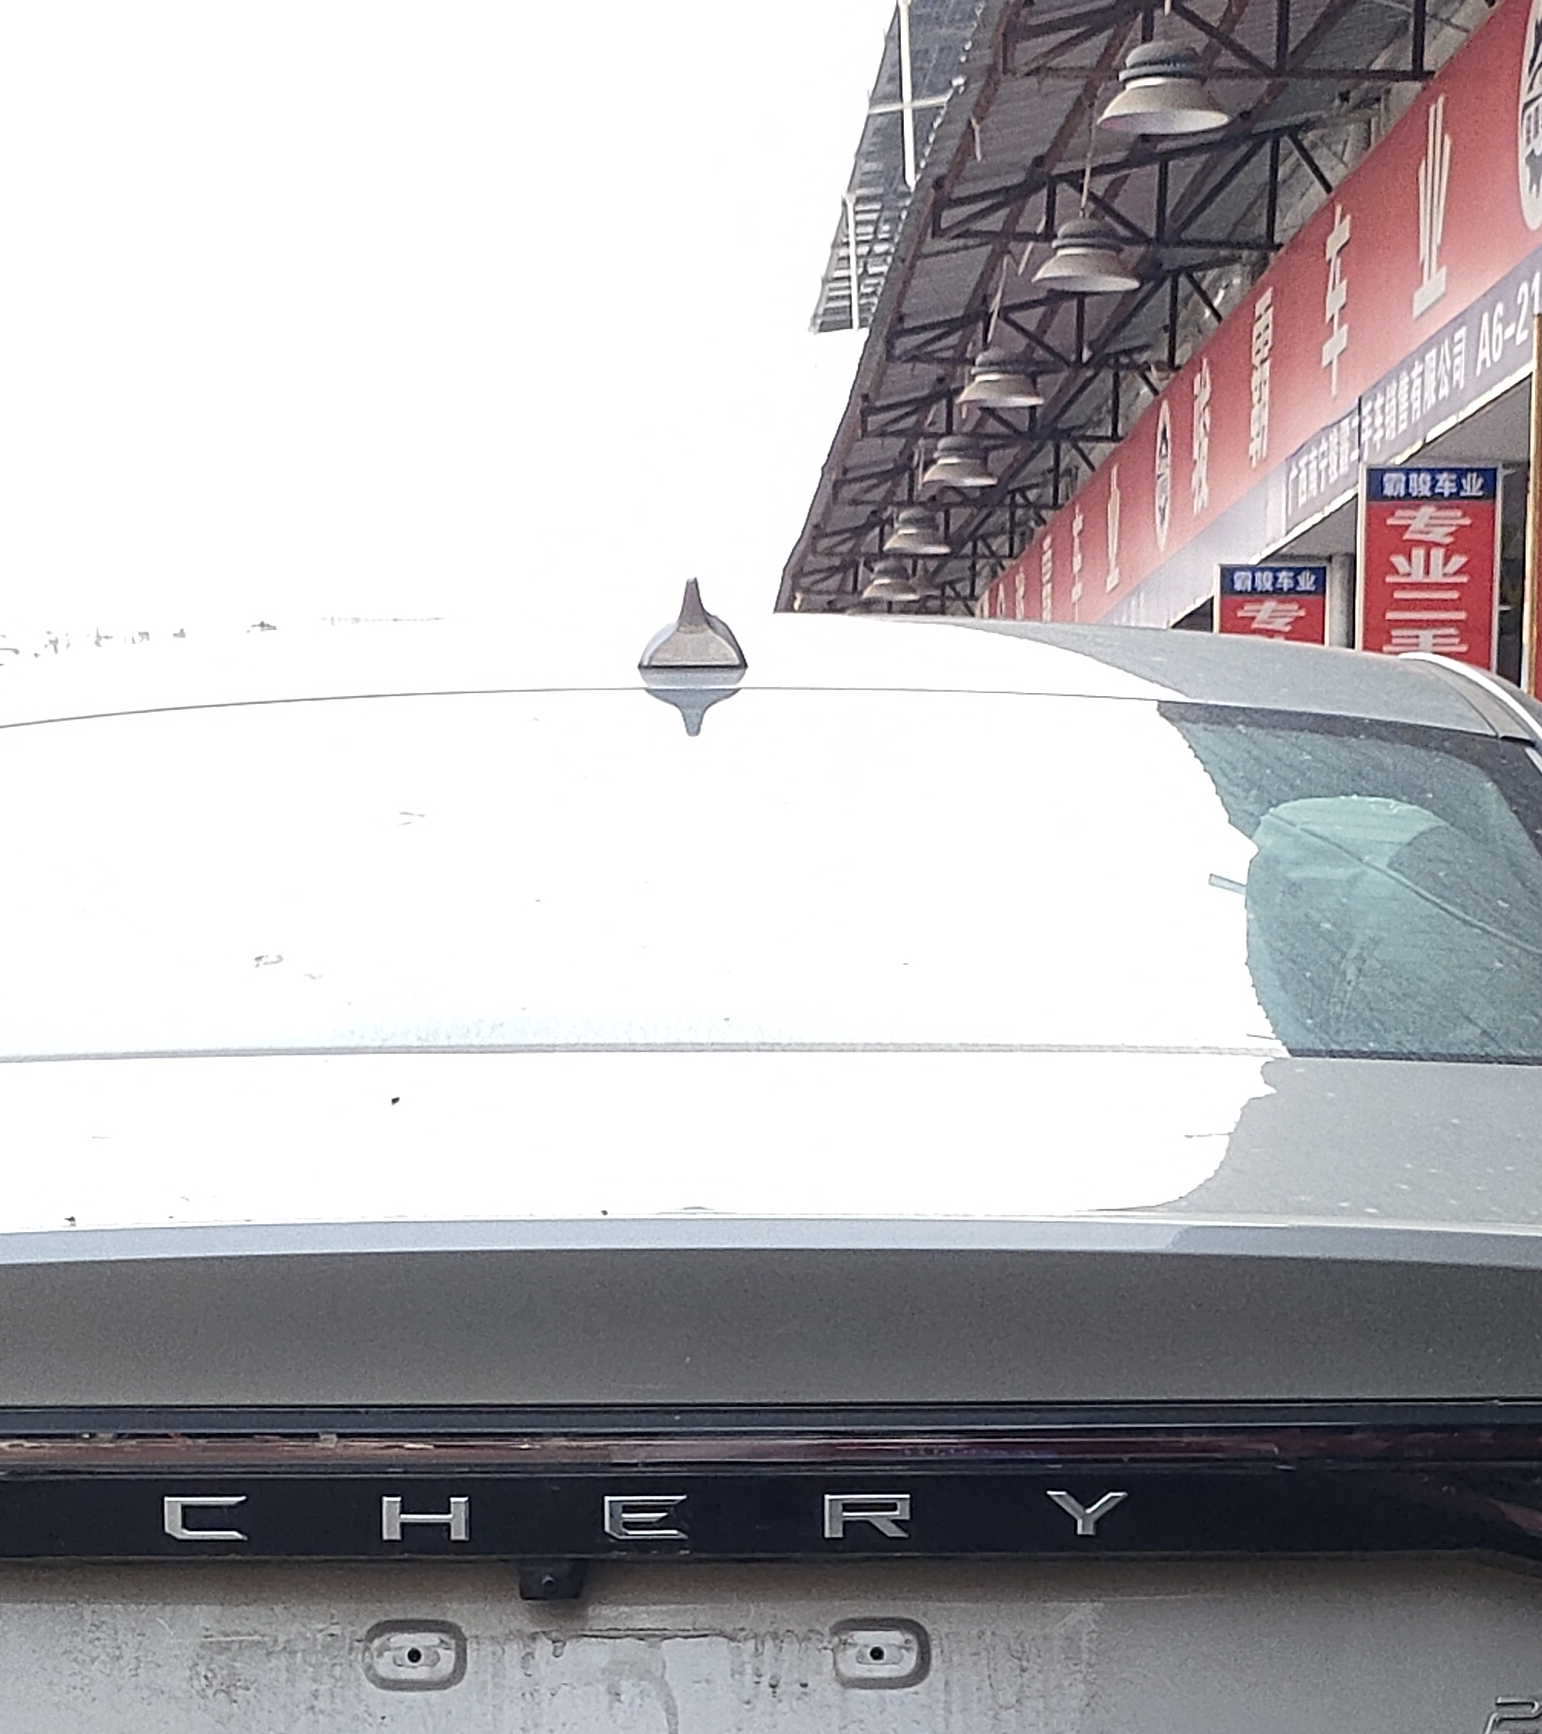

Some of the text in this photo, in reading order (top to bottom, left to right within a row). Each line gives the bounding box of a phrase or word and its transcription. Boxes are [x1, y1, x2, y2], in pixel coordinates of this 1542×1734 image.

[1382, 472, 1485, 498] 霸骏车业
[163, 1489, 1128, 1542] CHERY
